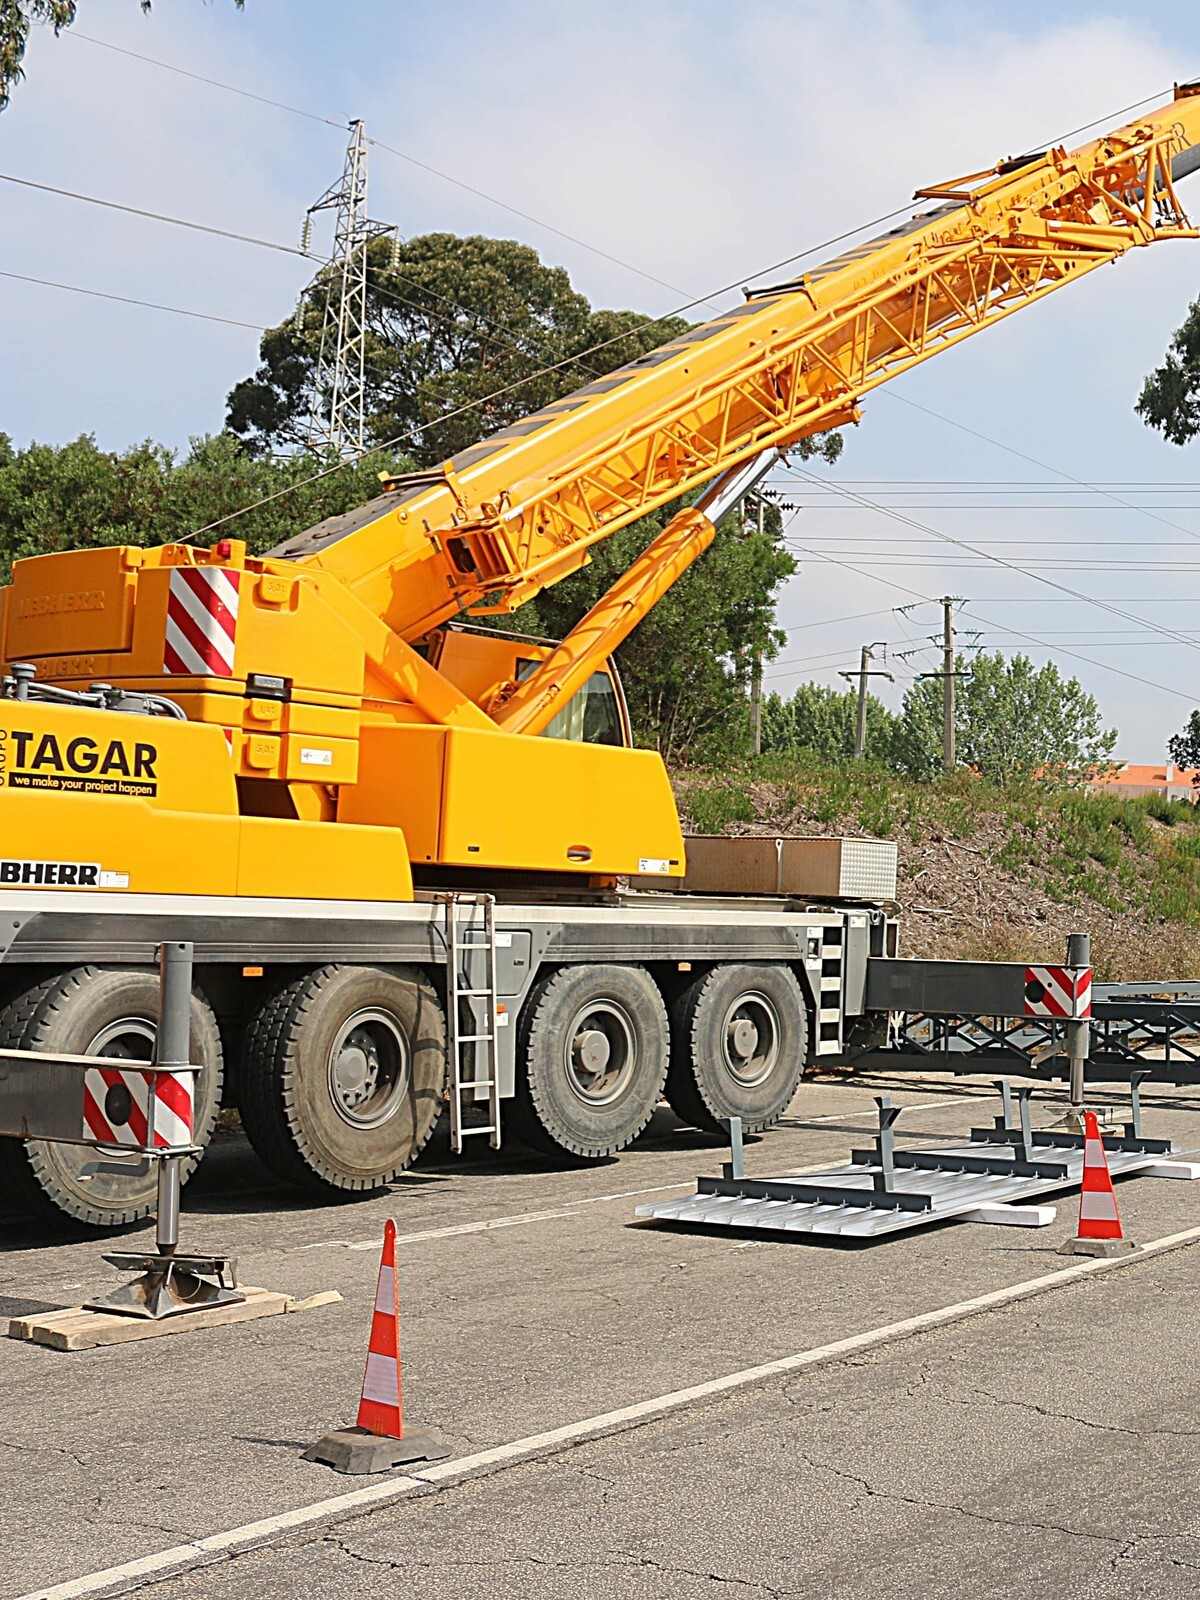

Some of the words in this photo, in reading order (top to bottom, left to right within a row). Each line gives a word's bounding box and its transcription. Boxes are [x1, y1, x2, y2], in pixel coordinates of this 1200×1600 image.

[11, 731, 157, 779] TAGAR
[14, 776, 30, 785] we
[32, 775, 59, 787] make
[60, 781, 83, 791] your
[85, 781, 117, 793] project
[119, 781, 152, 795] happen
